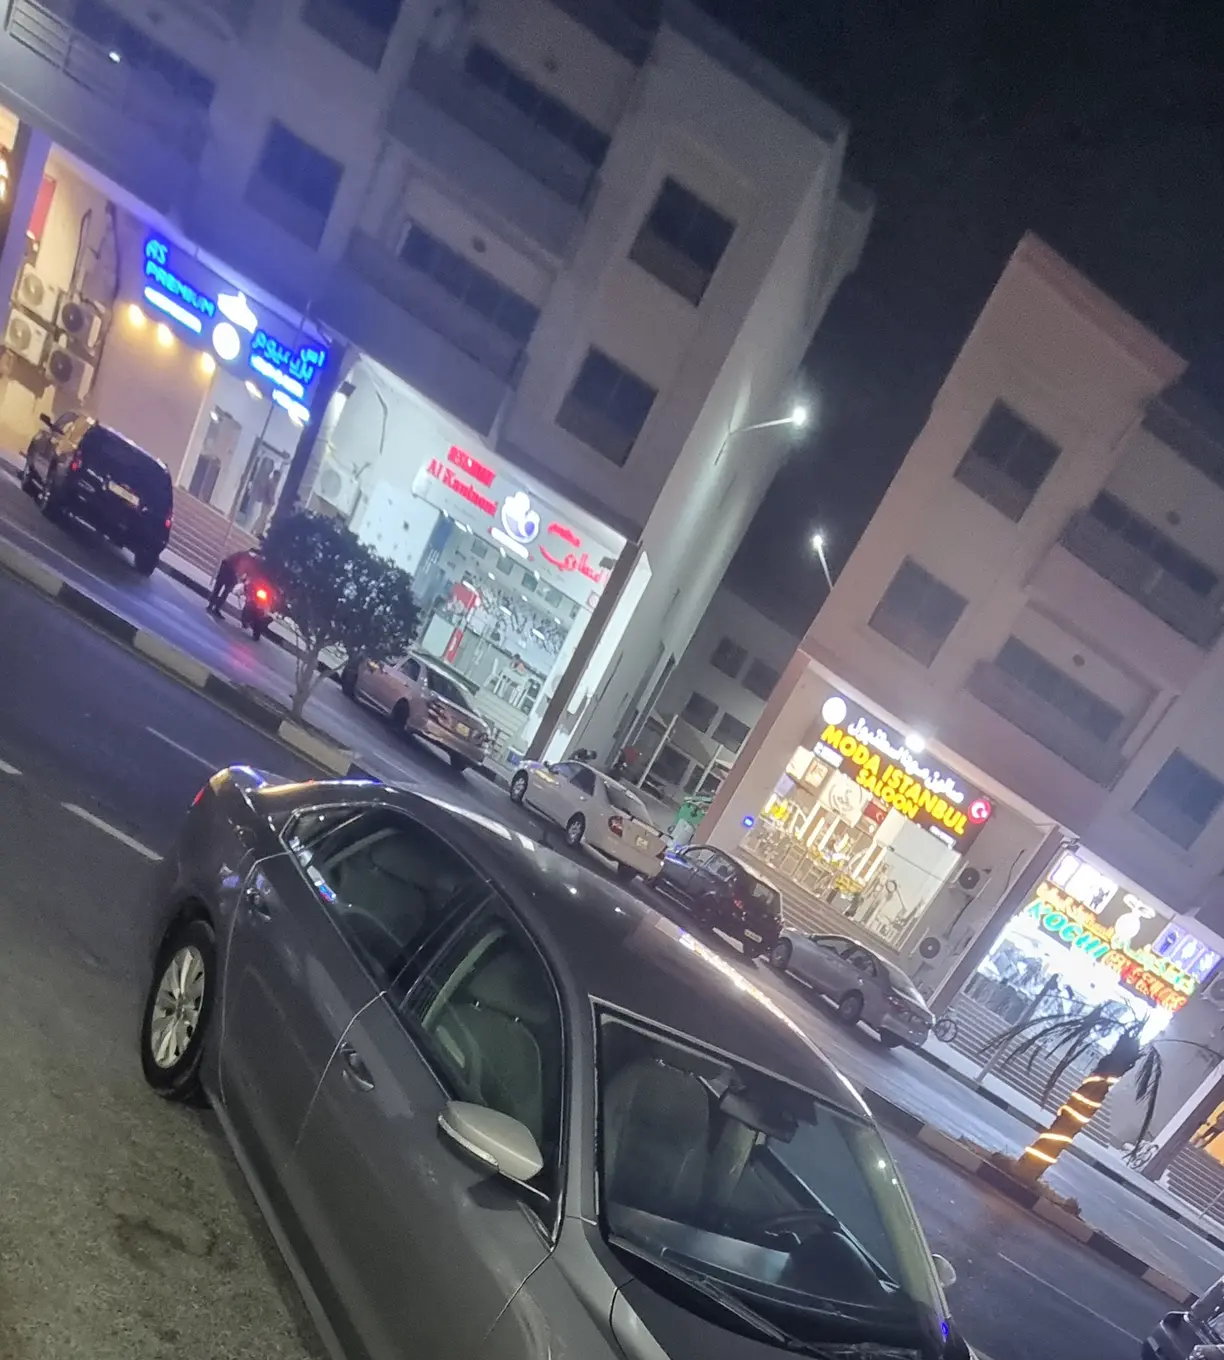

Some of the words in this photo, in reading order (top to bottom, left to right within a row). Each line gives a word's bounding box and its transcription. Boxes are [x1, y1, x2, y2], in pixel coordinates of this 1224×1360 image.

[145, 239, 169, 265] AS
[145, 260, 216, 317] PREMIUM
[820, 723, 882, 777] MODA
[881, 764, 968, 836] ISTANBUL
[855, 768, 920, 819] SALOON
[1027, 899, 1111, 959] KOCHI
